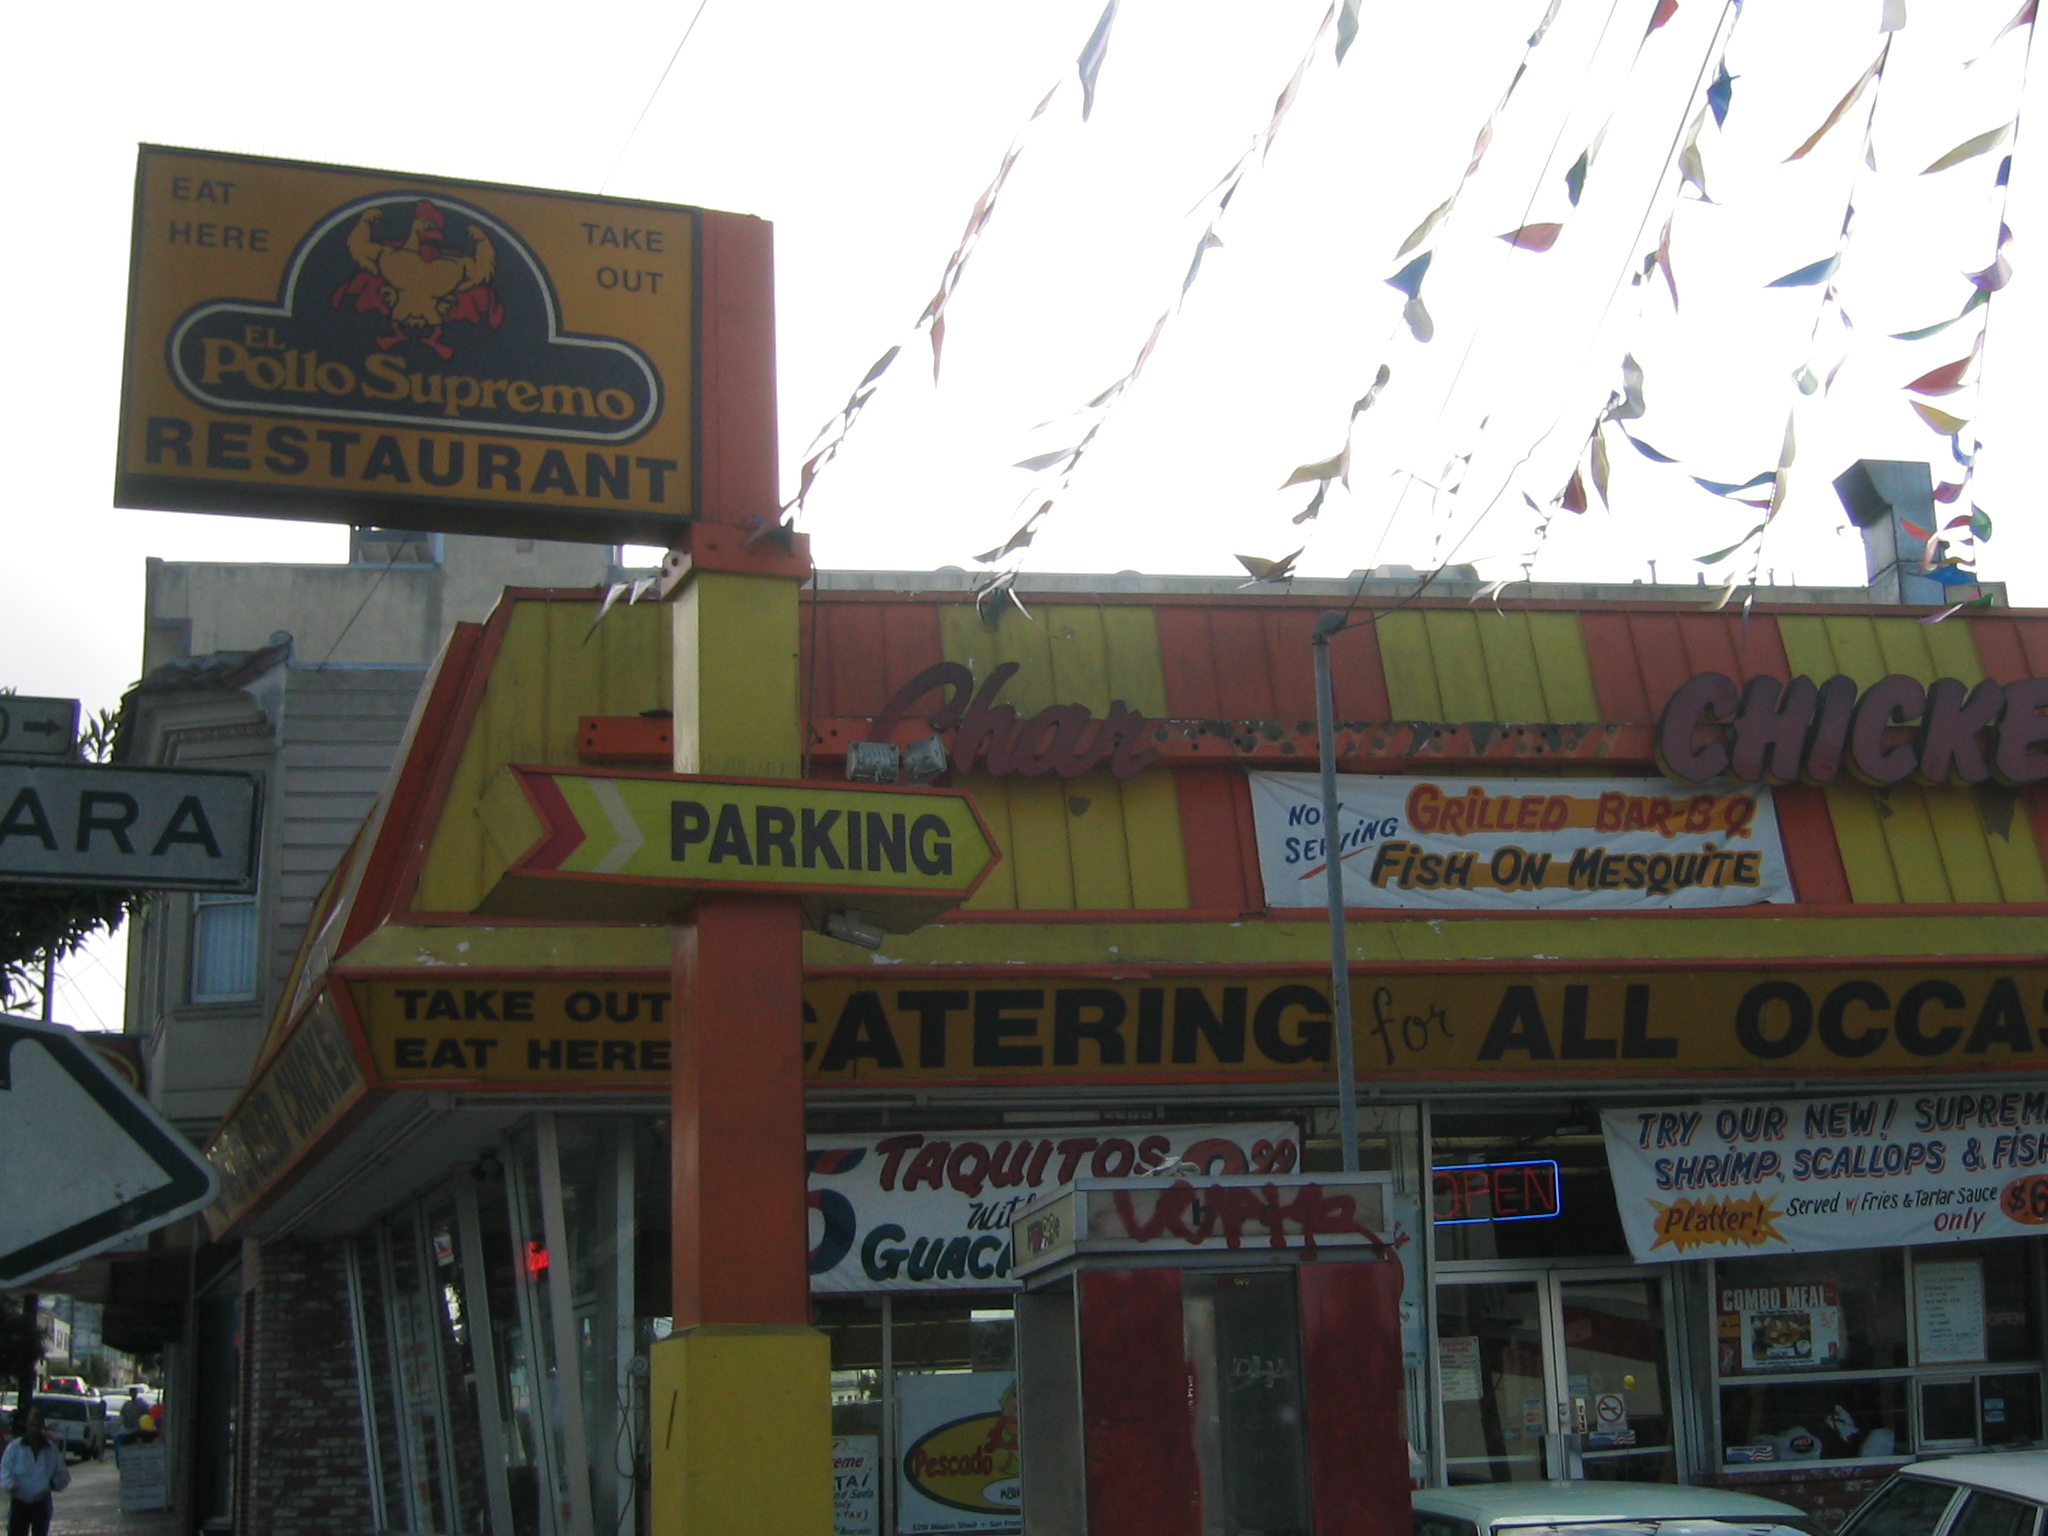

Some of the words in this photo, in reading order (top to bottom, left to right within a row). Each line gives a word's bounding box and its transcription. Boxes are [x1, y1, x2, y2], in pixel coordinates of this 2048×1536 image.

[172, 176, 236, 205] EAT
[169, 220, 270, 252] HERE
[582, 223, 664, 253] TAKE
[596, 265, 664, 294] OUT
[245, 325, 286, 351] EL
[202, 338, 356, 397] Pollo
[362, 357, 635, 421] Supremo
[145, 417, 678, 502] RESTAURANT
[1289, 802, 1344, 826] NO
[670, 800, 953, 876] PARKING
[1492, 846, 1553, 887] ON
[395, 990, 534, 1022] TAKE
[564, 990, 671, 1022] OUT
[1370, 986, 1454, 1065] for
[1477, 983, 1680, 1061] ALL
[1734, 976, 2048, 1060] OCCA
[394, 1037, 497, 1069] EAT
[528, 1039, 671, 1071] HERE
[1637, 1111, 1701, 1149] TRY
[1715, 1106, 1788, 1145] OUR
[1914, 1090, 2048, 1133] SUPREM
[875, 1133, 1172, 1198] TAQUITOS
[1793, 1139, 1946, 1181] SCALLOPS
[1961, 1136, 1986, 1171] &
[1432, 1167, 1555, 1219] OPEN
[1786, 1192, 1839, 1217] Served
[1861, 1189, 1898, 1211] Fries
[1902, 1193, 1913, 1208] &
[1915, 1187, 1956, 1208] Tartar
[1956, 1185, 1998, 1205] Sauce
[967, 1192, 1036, 1231] Wit
[1664, 1204, 1765, 1237] Platter!
[1722, 1287, 1781, 1312] COMBO
[1785, 1284, 1826, 1309] MEAL
[912, 1445, 993, 1479] Pescado
